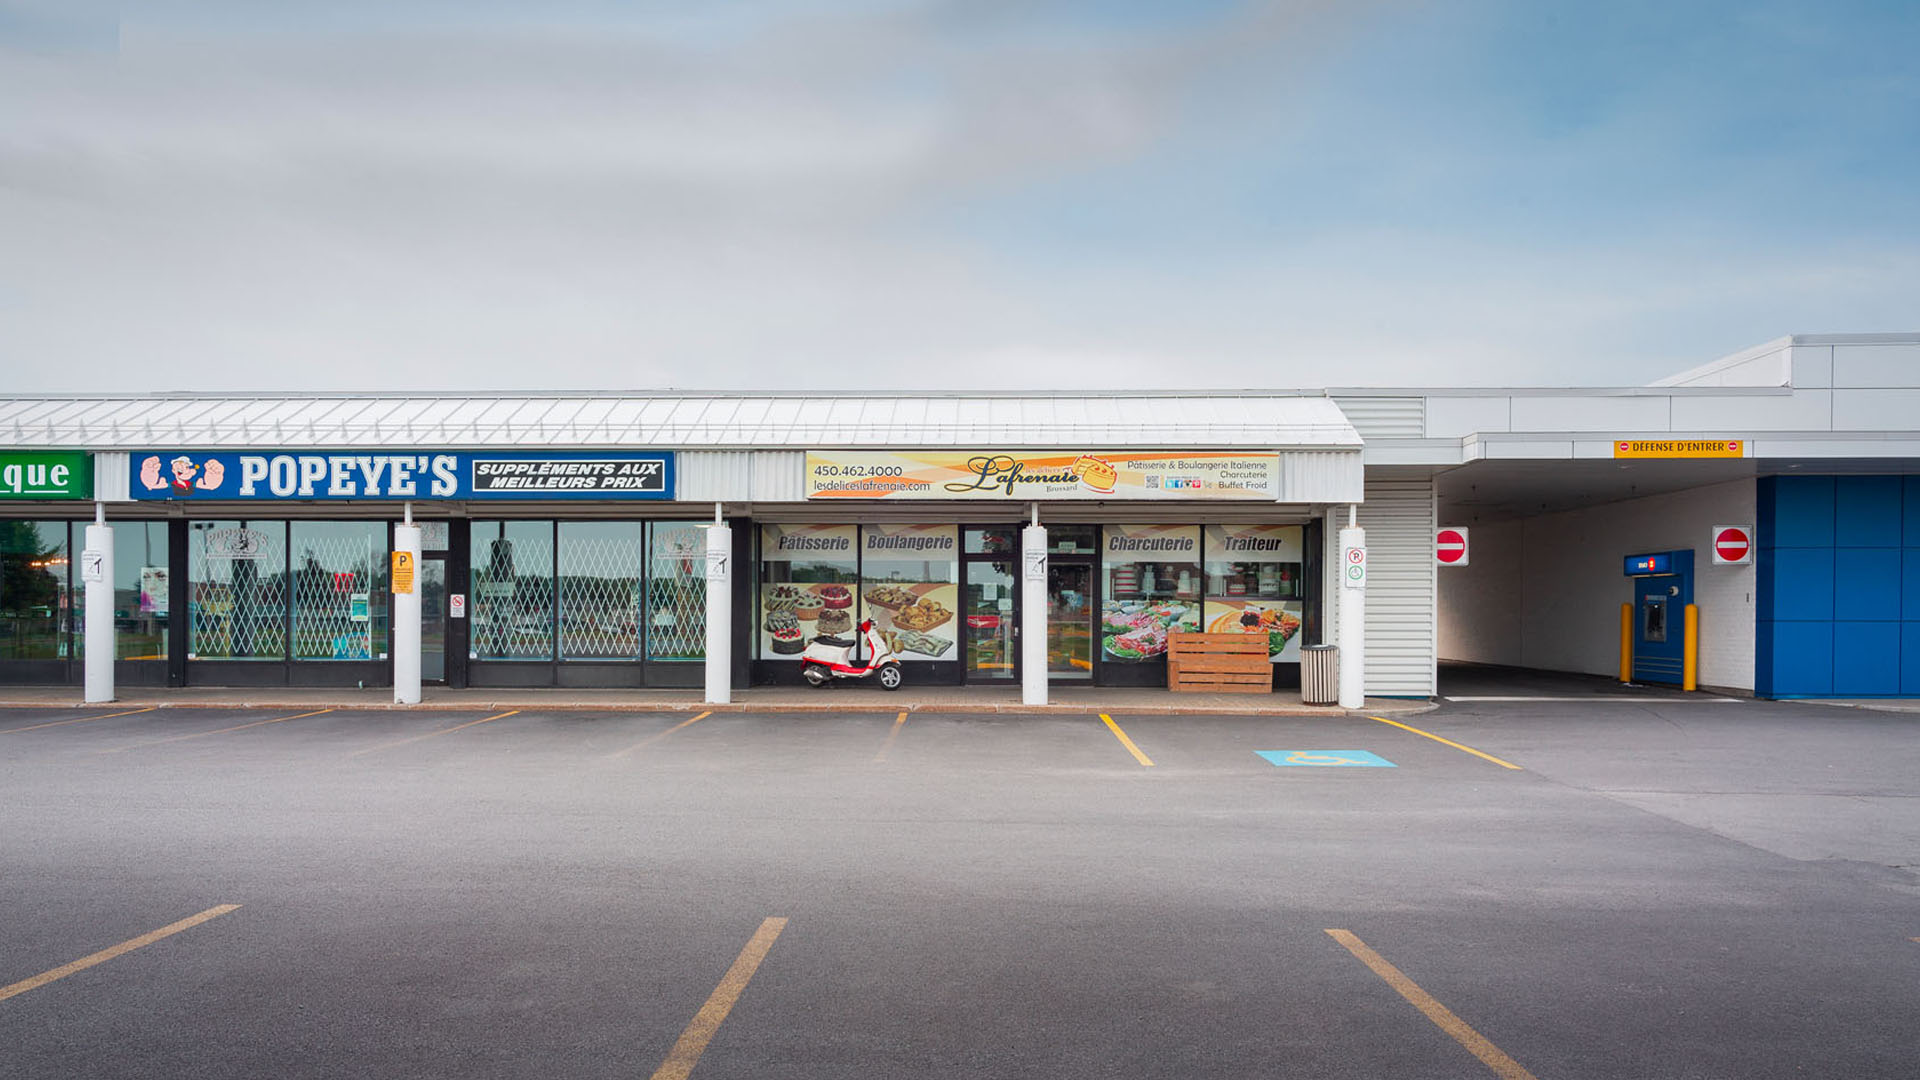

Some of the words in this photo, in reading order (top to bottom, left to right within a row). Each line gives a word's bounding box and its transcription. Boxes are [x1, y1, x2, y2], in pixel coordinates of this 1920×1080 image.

[1677, 442, 1724, 451] D'ENTRER
[477, 462, 616, 475] SUPPLÉMENTS
[617, 464, 661, 475] AUX
[814, 466, 903, 476] 450.462.4000
[1127, 461, 1166, 469] Pâtisserie
[1169, 461, 1175, 469] &
[1178, 461, 1228, 471] Boulangerie
[1231, 461, 1267, 469] Italienne
[3, 464, 70, 493] que
[239, 455, 458, 497] POPEYE'S
[944, 455, 1079, 496] Lafrenaie
[489, 477, 597, 488] MEILLEURS
[600, 477, 647, 488] PRIX
[814, 480, 931, 491] lesdeliceslafrenaie.com
[1219, 481, 1242, 489] Buffet
[1246, 481, 1267, 489] Froid
[779, 536, 849, 549] Pâtisserie
[867, 535, 953, 550] Boulangerie
[1109, 537, 1193, 550] Charcuterie
[1224, 537, 1281, 550] Traiteur
[399, 555, 407, 566] P
